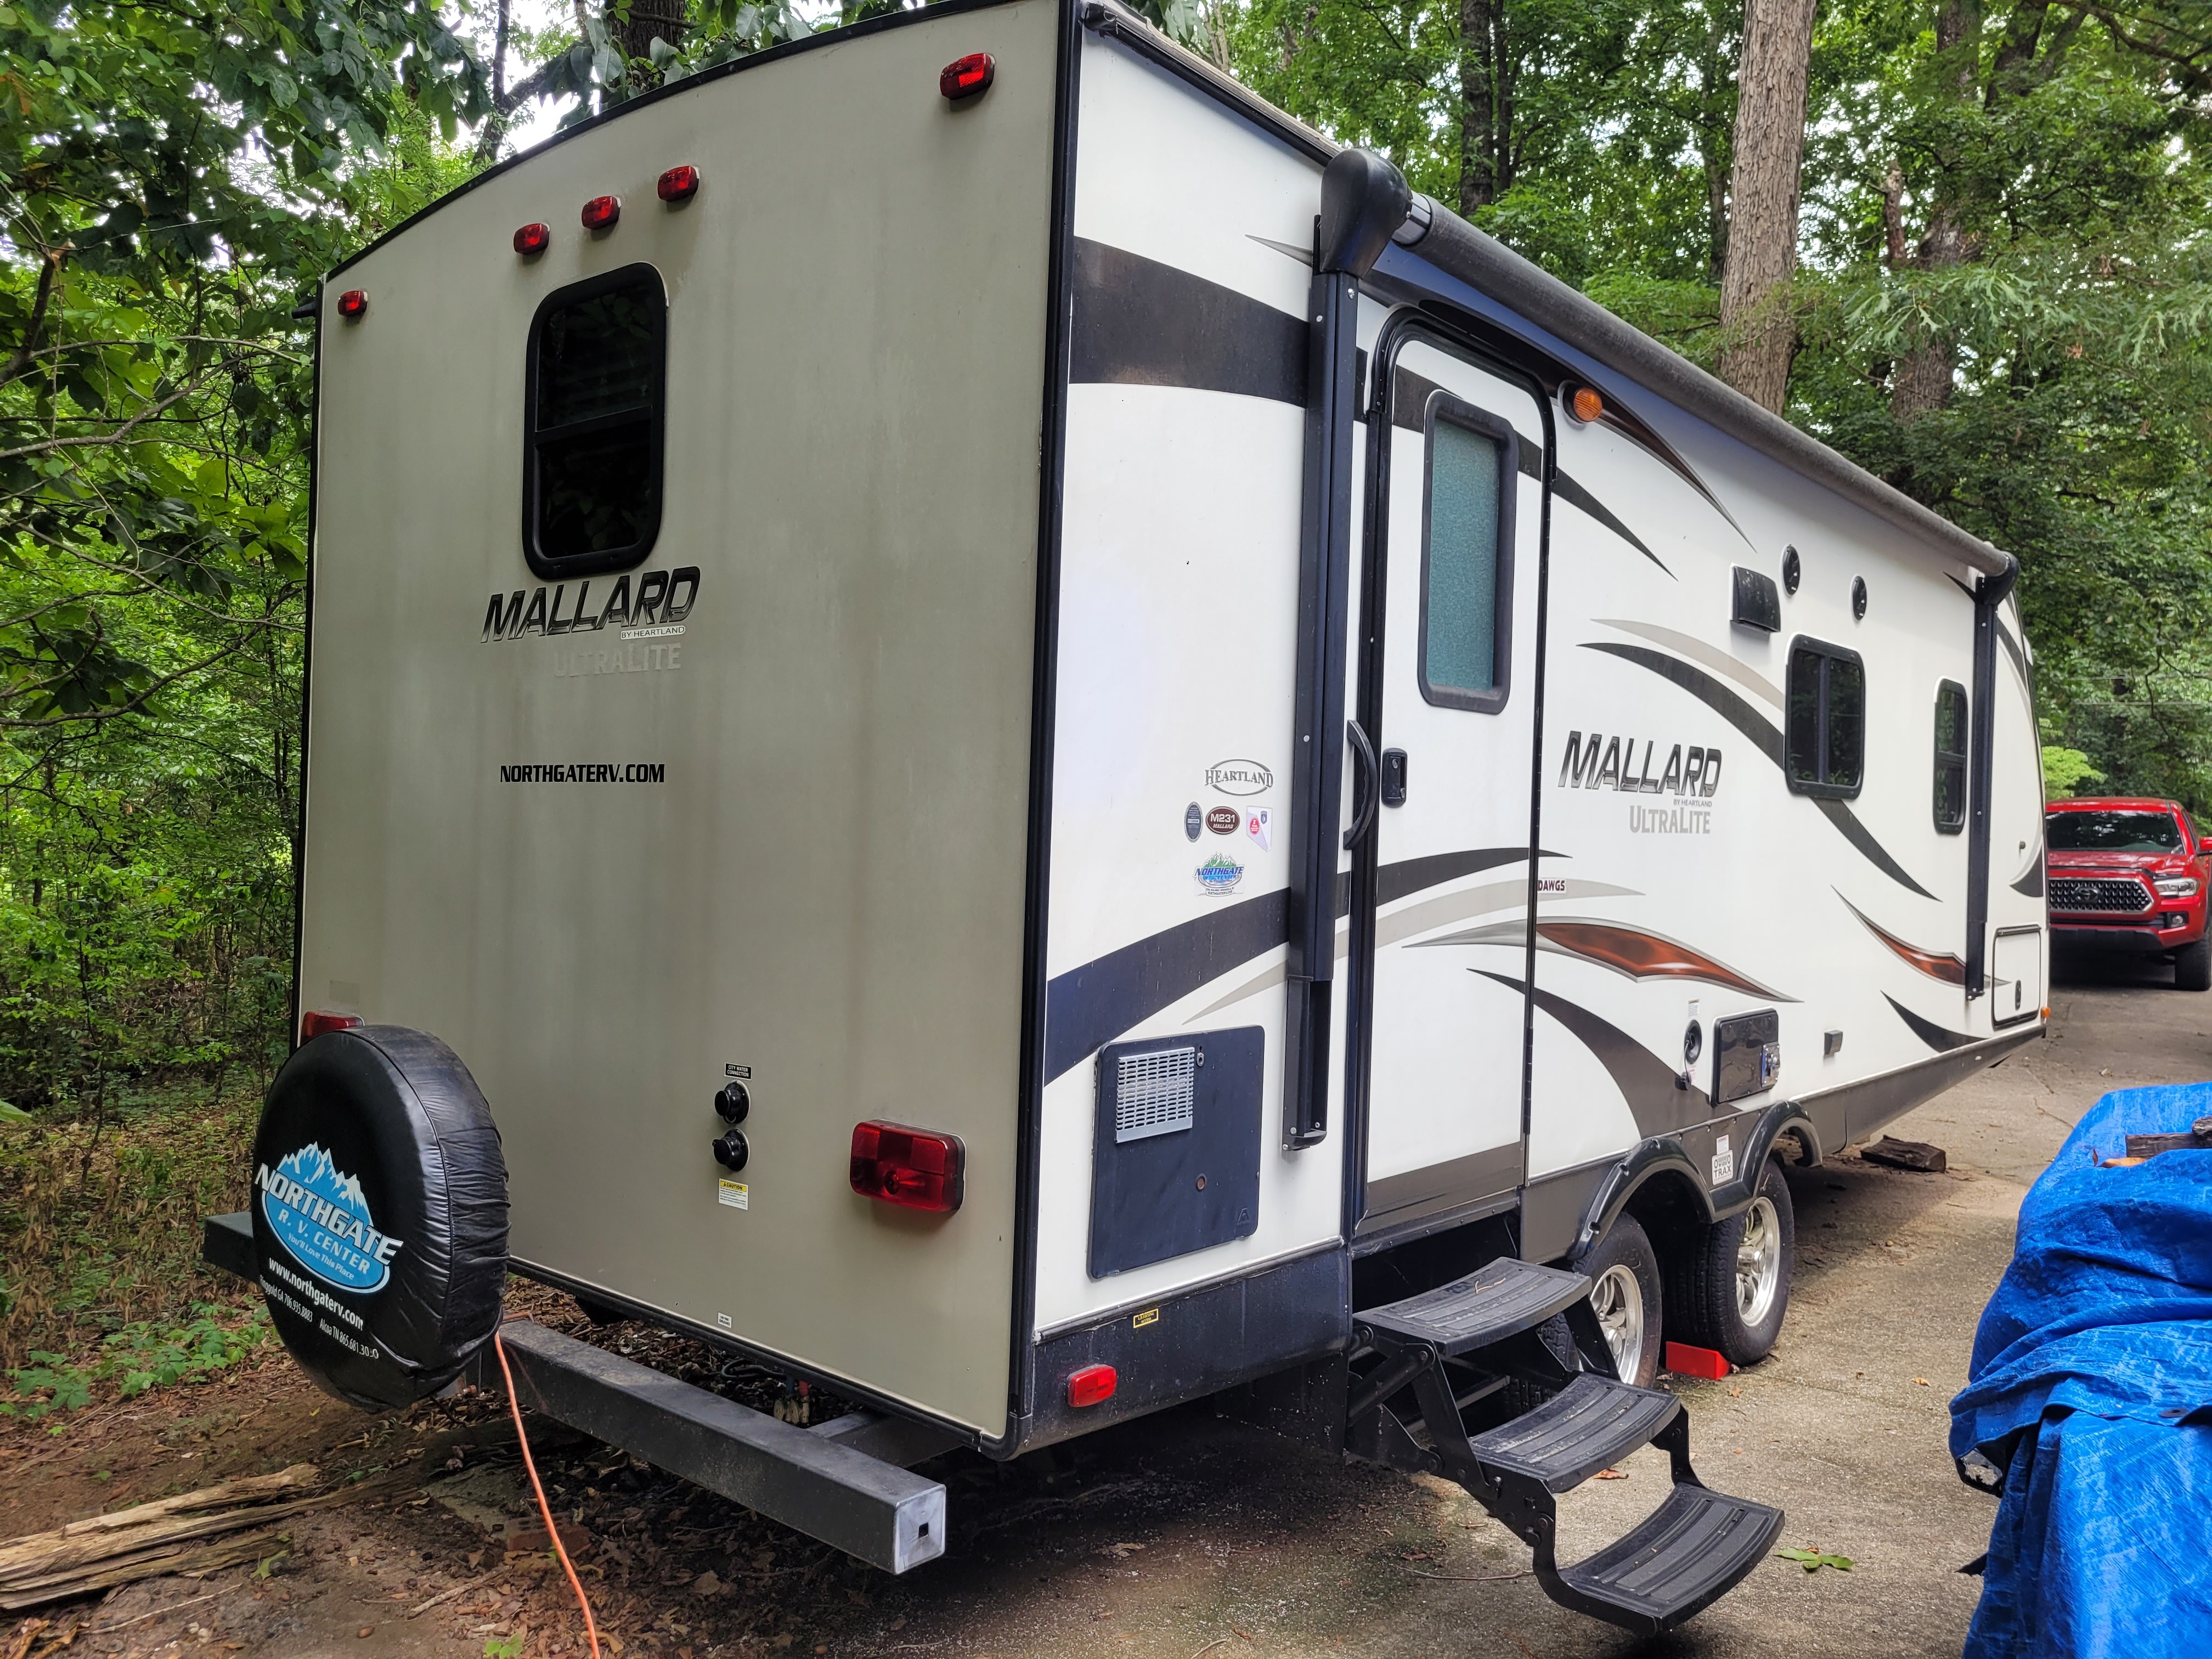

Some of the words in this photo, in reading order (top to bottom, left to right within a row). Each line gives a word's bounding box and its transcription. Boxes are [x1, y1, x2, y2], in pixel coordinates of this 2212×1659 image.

[481, 566, 701, 644] MALLARD
[621, 630, 632, 639] BY
[634, 627, 685, 637] HEARTLAND
[1558, 730, 1722, 797] MALLARD
[500, 764, 665, 783] NORTHGATERV.COM
[1204, 769, 1274, 788] HEARTLAND
[1210, 813, 1235, 823] M231
[1195, 866, 1244, 876] NORTHGATE
[1537, 879, 1565, 891] DAWGS
[1713, 1164, 1731, 1178] TRAX
[254, 1163, 404, 1265] NORTHGATE
[287, 1232, 306, 1248] You'll
[304, 1243, 320, 1259] Love
[321, 1253, 336, 1268] This
[335, 1262, 355, 1280] Place
[313, 1231, 371, 1275] CENTER
[269, 1257, 364, 1331] www.northgaterv.com
[277, 1290, 284, 1302] GA
[319, 1318, 332, 1336] Alcoa
[332, 1325, 339, 1341] TN
